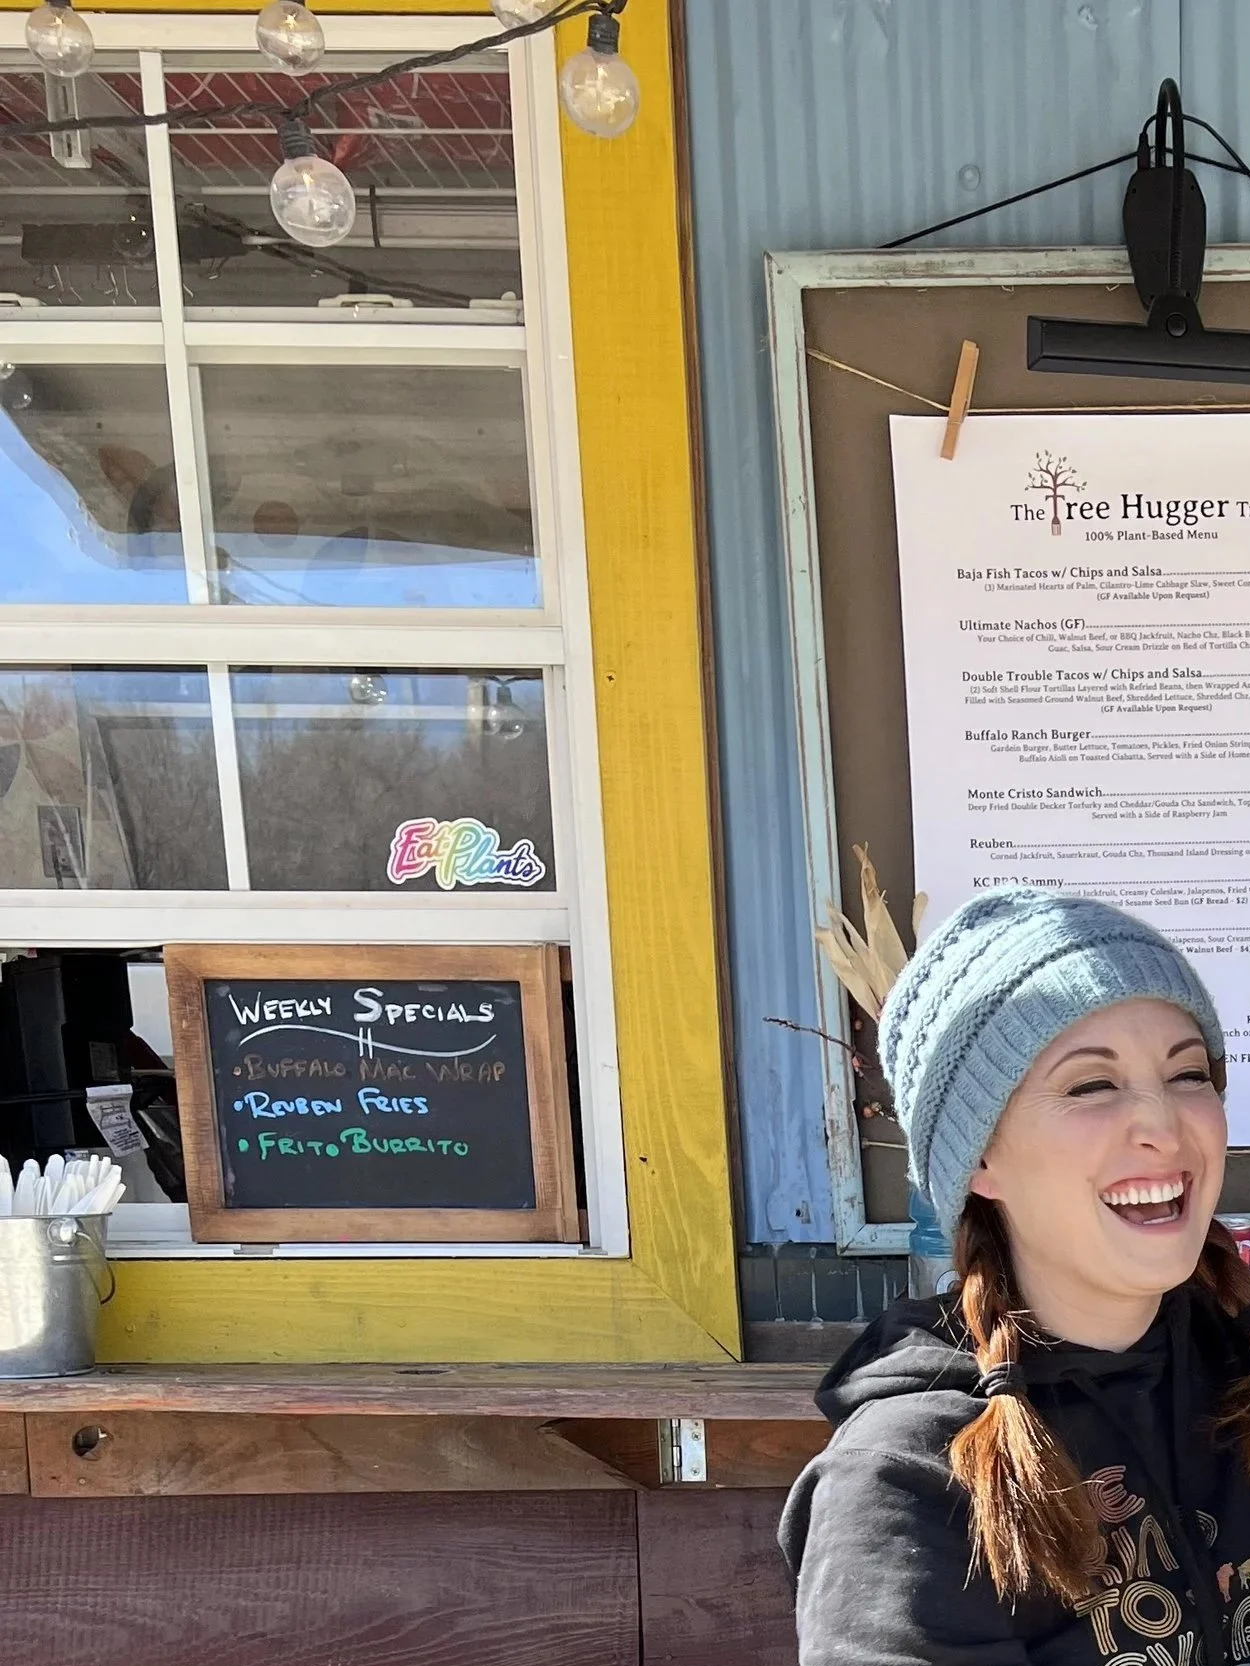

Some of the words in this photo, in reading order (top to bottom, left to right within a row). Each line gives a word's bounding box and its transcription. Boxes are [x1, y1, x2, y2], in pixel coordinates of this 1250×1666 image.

[1010, 504, 1046, 521] The
[1045, 495, 1110, 526] Tree
[1120, 493, 1229, 526] Hugger
[1085, 531, 1114, 542] 100%
[1117, 529, 1184, 541] Plant-Based
[1186, 529, 1219, 540] Menu
[957, 568, 983, 582] Baja
[986, 567, 1011, 580] Fish
[1013, 567, 1049, 579] Tacos
[1050, 566, 1068, 579] w/
[1069, 566, 1104, 581] Chips
[1106, 565, 1129, 578] and
[1131, 565, 1162, 578] Salsa
[1096, 592, 1111, 602] (GF
[1112, 591, 1151, 600] Available
[1151, 591, 1174, 601] Upon
[1174, 590, 1210, 601] Request)
[959, 619, 1012, 631] Ultimate
[1014, 618, 1058, 630] Nachos
[1060, 618, 1086, 631] (GF)
[962, 670, 1004, 682] Double
[1005, 669, 1053, 682] Trouble
[1055, 669, 1090, 681] Tacos
[1092, 668, 1108, 681] w/
[1110, 668, 1145, 682] Chips
[1146, 667, 1170, 679] and
[1172, 667, 1202, 679] Salsa
[1100, 704, 1115, 714] (GF
[1116, 704, 1154, 713] Available
[1155, 704, 1177, 714] Upon
[1177, 703, 1213, 713] Request)
[964, 729, 1009, 741] Buffalo
[1011, 729, 1048, 741] Ranch
[1051, 729, 1092, 742] Burger
[967, 789, 1005, 800] Monte
[1007, 788, 1044, 799] Cristo
[1046, 786, 1103, 799] Sandwich
[970, 838, 1014, 849] Reuben
[394, 822, 450, 876] Eat
[443, 825, 540, 882] Plants
[973, 877, 990, 888] KC
[1022, 876, 1064, 889] Sammy
[229, 991, 334, 1024] WEEKLY
[353, 987, 495, 1025] SPECIALS
[243, 1091, 343, 1119] REUBEN
[357, 1087, 430, 1116] FRIES
[340, 1127, 469, 1156] BURRITO
[1074, 1580, 1182, 1655] TO
